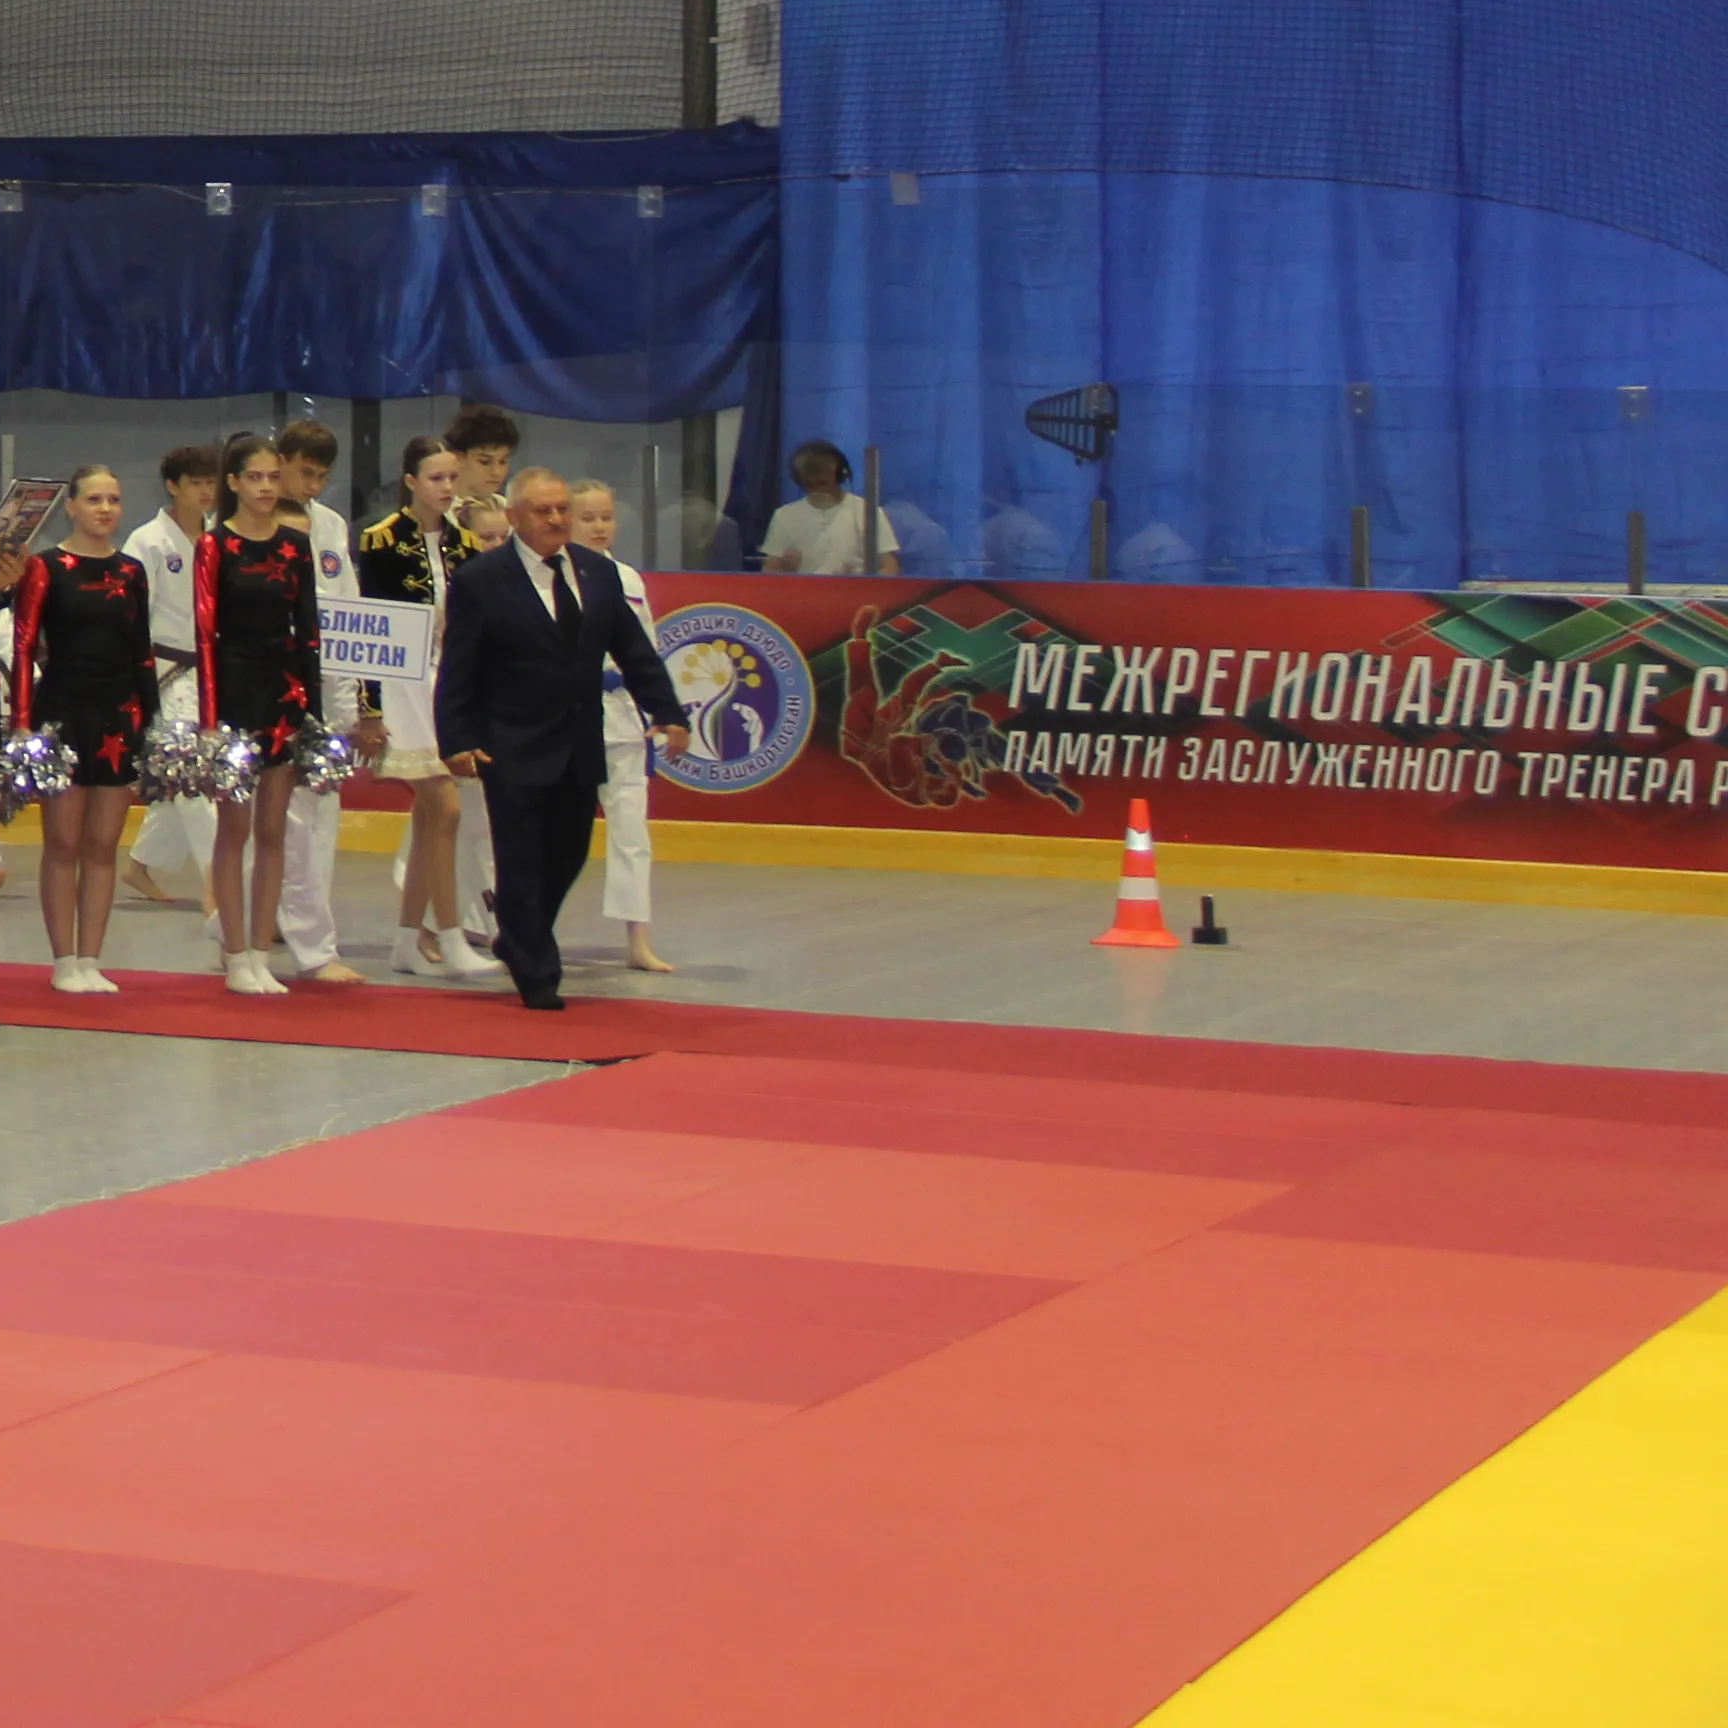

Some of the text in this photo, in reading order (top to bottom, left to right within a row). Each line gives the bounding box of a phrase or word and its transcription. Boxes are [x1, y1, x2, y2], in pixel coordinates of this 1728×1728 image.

[1008, 642, 1668, 735] МЕЖРЕГИОНАЛЬНЫЕ
[1003, 730, 1168, 779] ПАМЯТИ
[1178, 736, 1502, 795] ЗАСЛУЖЕННОГО
[1518, 751, 1696, 805] ТРЕНЕРА
